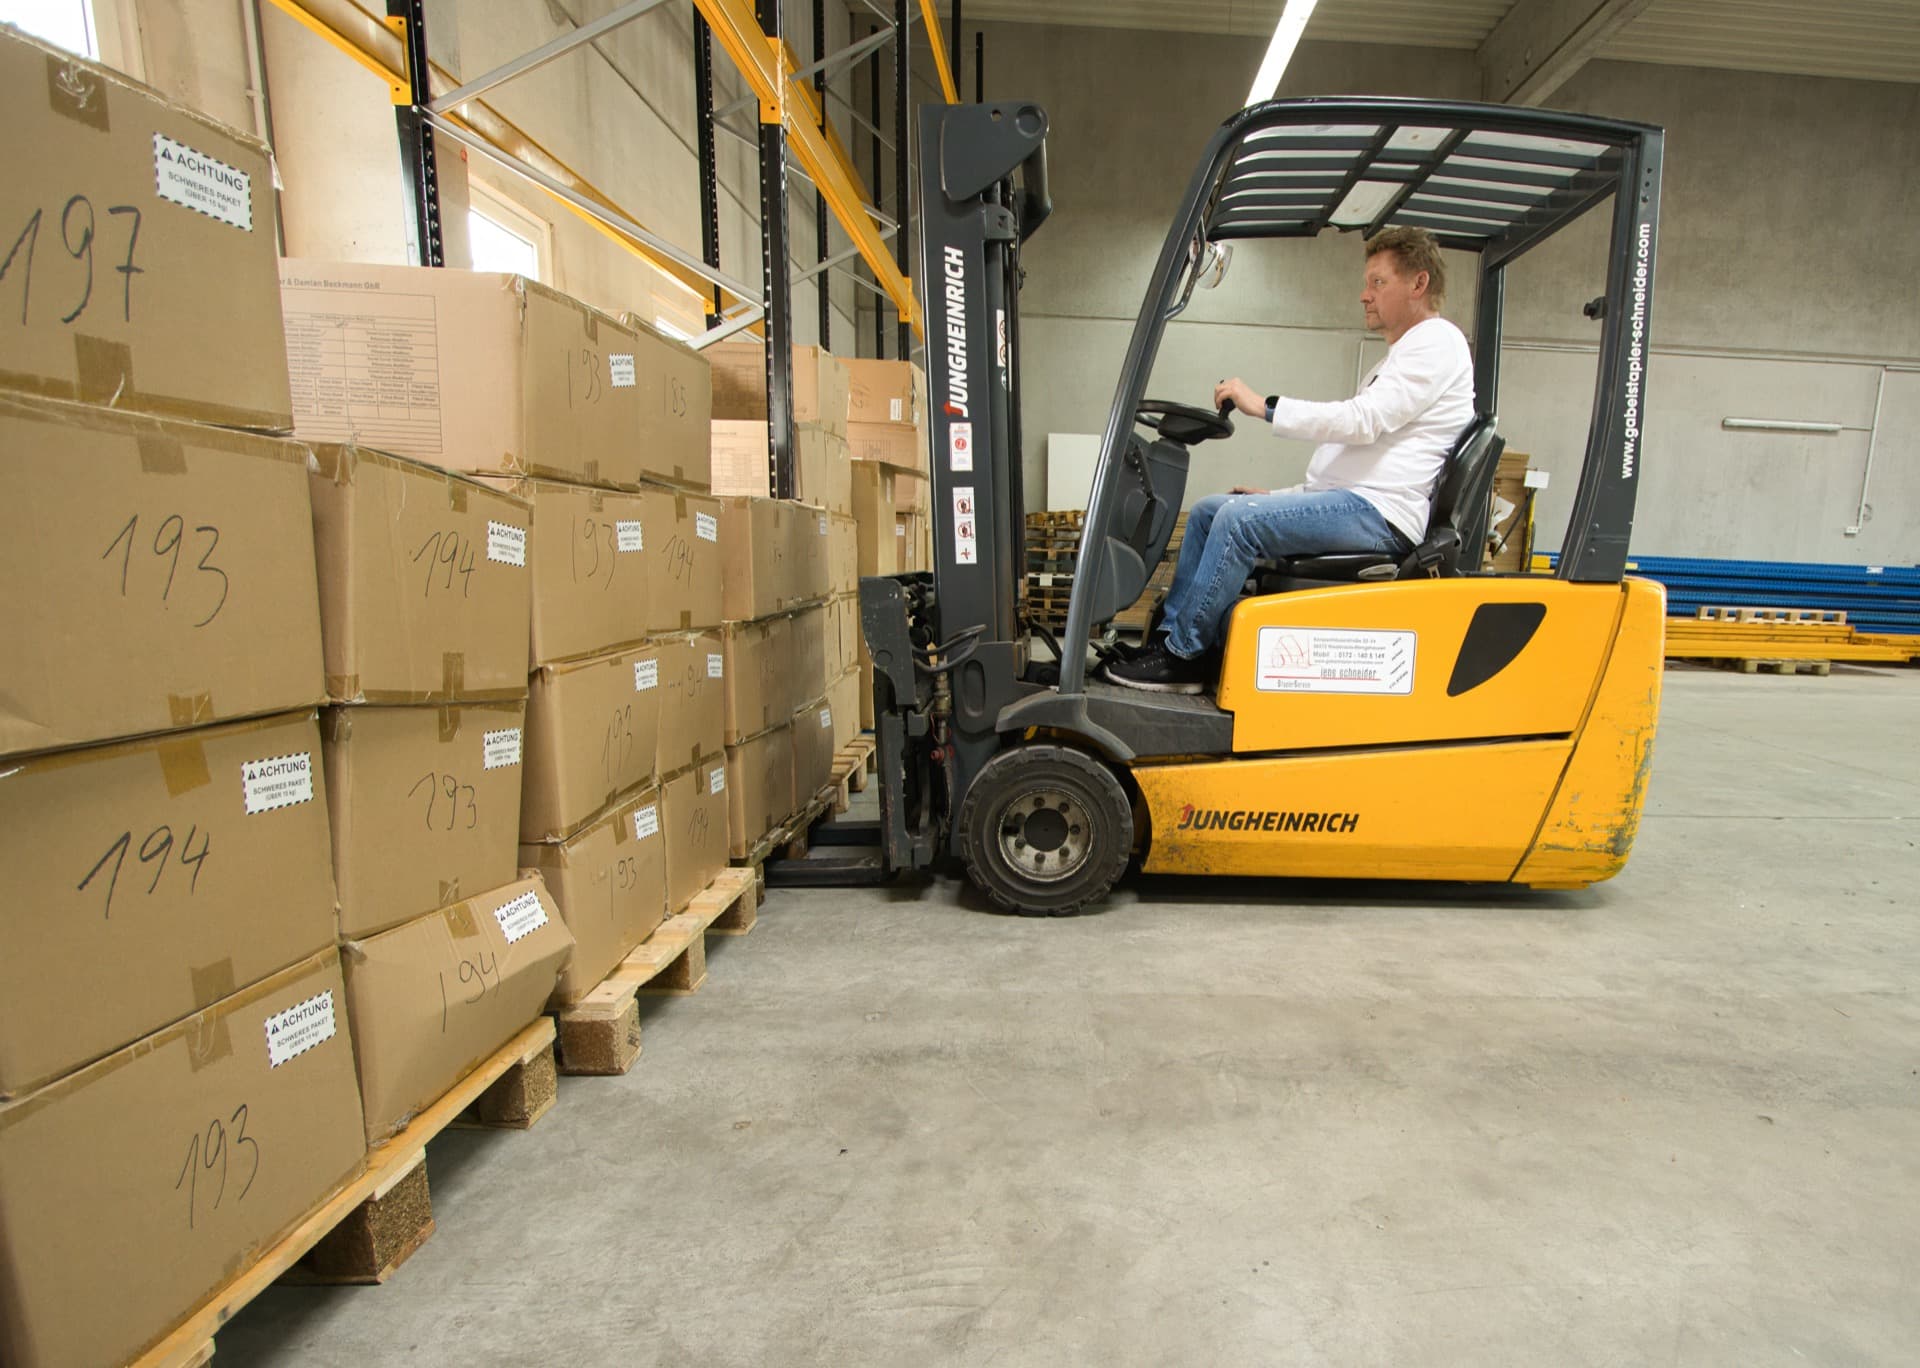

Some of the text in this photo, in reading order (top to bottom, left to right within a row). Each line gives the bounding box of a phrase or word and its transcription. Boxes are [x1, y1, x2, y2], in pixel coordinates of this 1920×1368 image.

[168, 171, 241, 208] SCHWERES PAKET
[177, 153, 243, 191] ACHTUNG
[0, 194, 144, 326] 197
[944, 245, 969, 418] JUNGHEINRICH
[1621, 223, 1651, 480] www.gabelstapler-schneider.com
[568, 349, 601, 409] 193
[496, 527, 523, 542] ACHTUNG
[572, 514, 615, 591] 193
[662, 534, 694, 590] 194
[102, 514, 228, 628] 193
[413, 531, 475, 598] 194
[492, 733, 518, 745] ACHTUNG
[253, 778, 306, 795] SCHWERES PAKET
[259, 760, 306, 778] ACHTUNG
[1177, 803, 1360, 833] JUNGHEINRICH
[77, 824, 210, 920] 194
[610, 856, 637, 921] 193
[506, 896, 536, 918] ACHTUNG
[282, 999, 329, 1030] ACHTUNG
[440, 951, 501, 1033] 194
[276, 1016, 328, 1047] SCHWERES PAKET
[175, 1103, 259, 1231] 193
